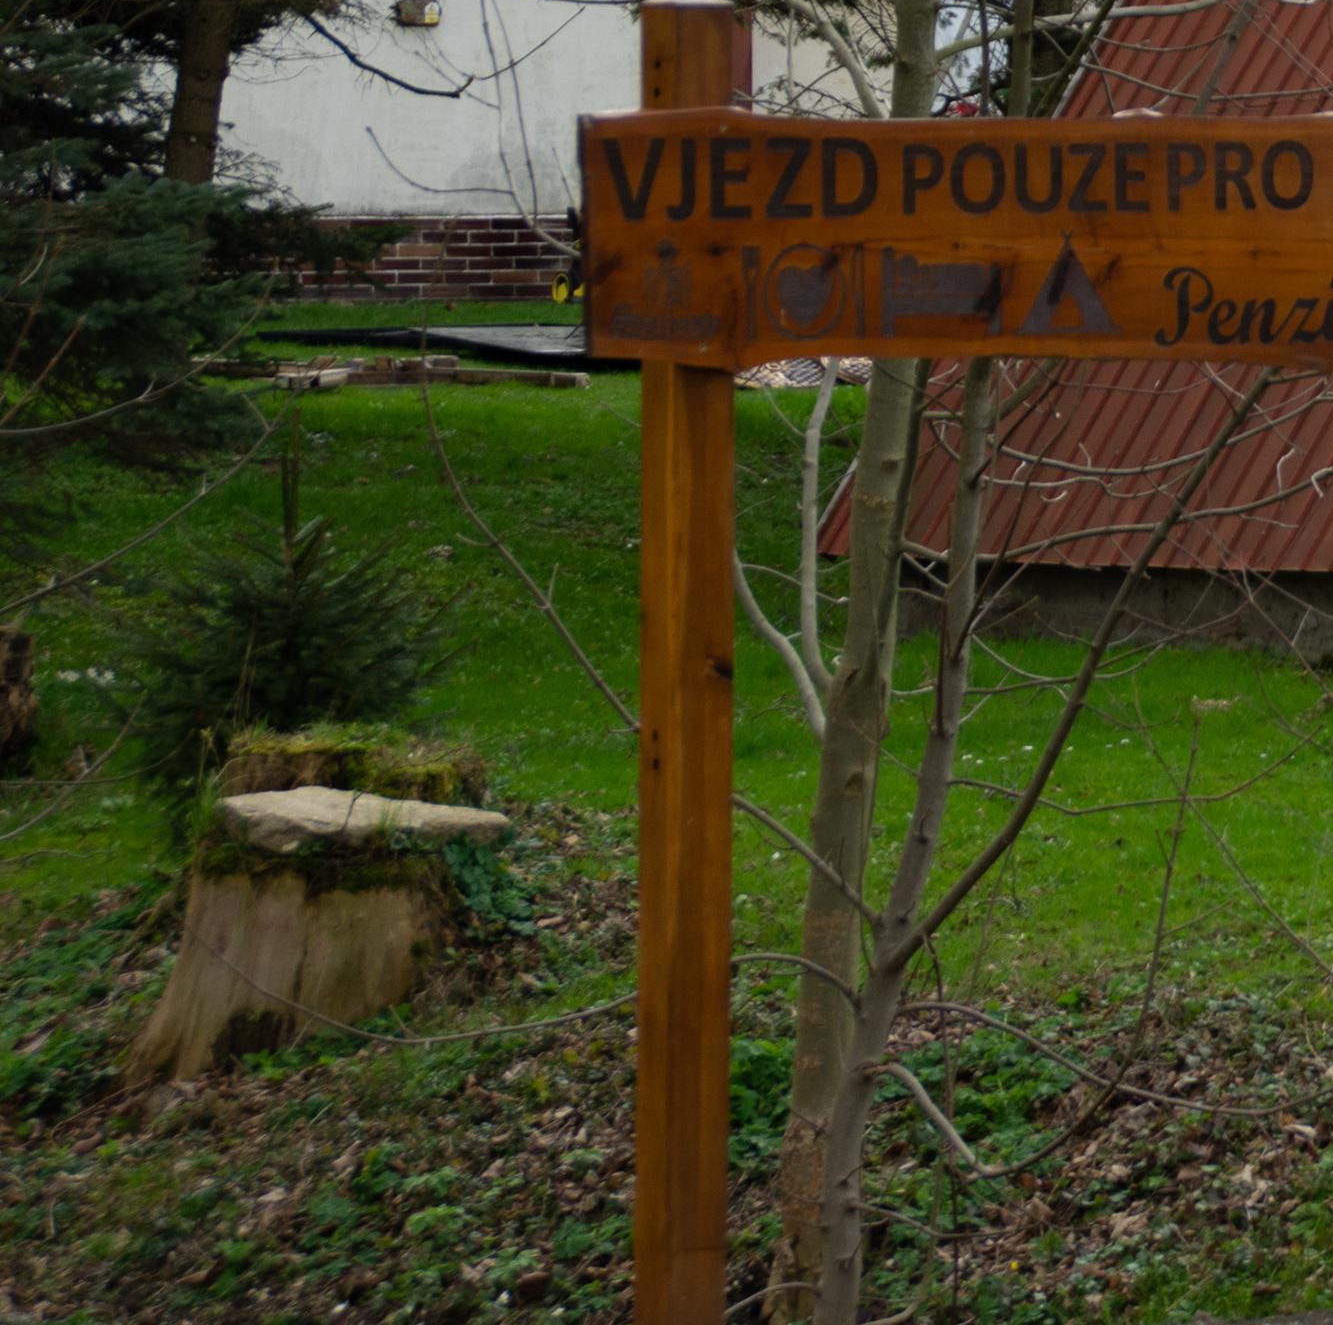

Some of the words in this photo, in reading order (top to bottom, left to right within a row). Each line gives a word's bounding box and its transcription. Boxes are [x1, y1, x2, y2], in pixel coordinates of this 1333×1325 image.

[601, 137, 878, 223] VJEZD
[902, 142, 1150, 216] POUZE
[1166, 139, 1314, 213] PRO
